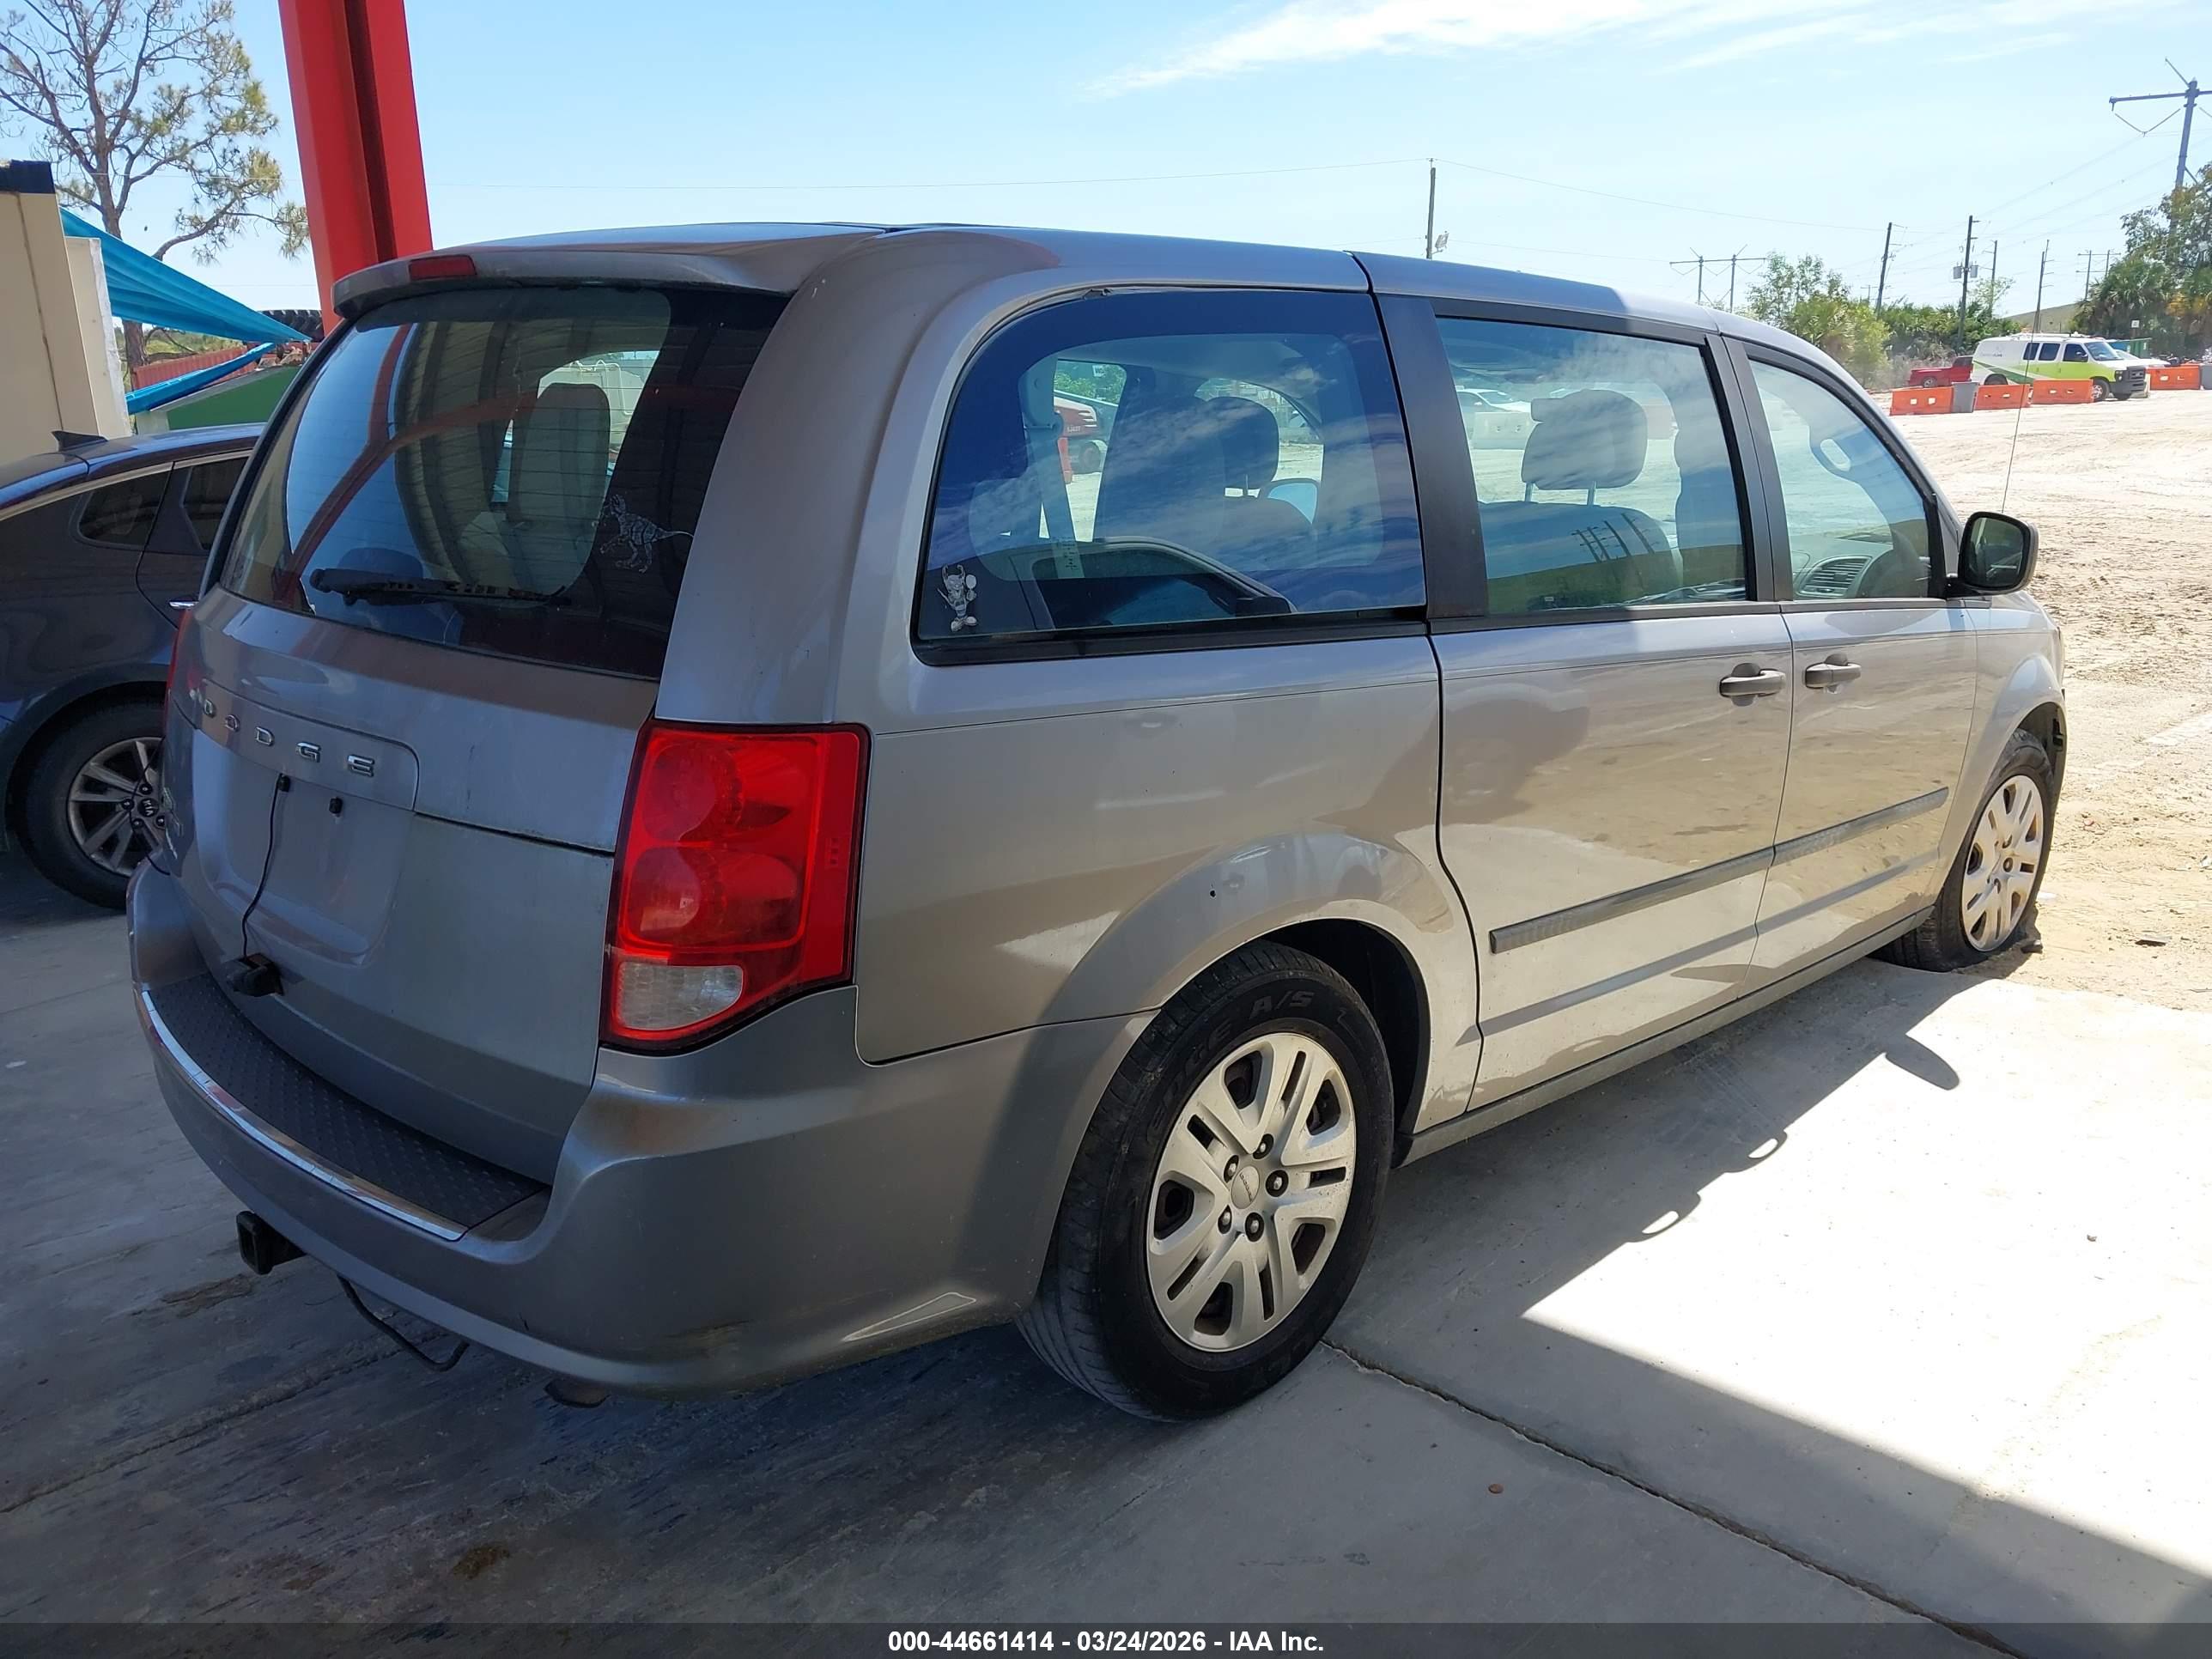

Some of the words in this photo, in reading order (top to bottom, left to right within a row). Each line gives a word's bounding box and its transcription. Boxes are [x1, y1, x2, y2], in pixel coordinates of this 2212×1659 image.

[203, 697, 376, 778] DODGE
[142, 799, 155, 816] KIA
[1249, 989, 1316, 1020] A/S
